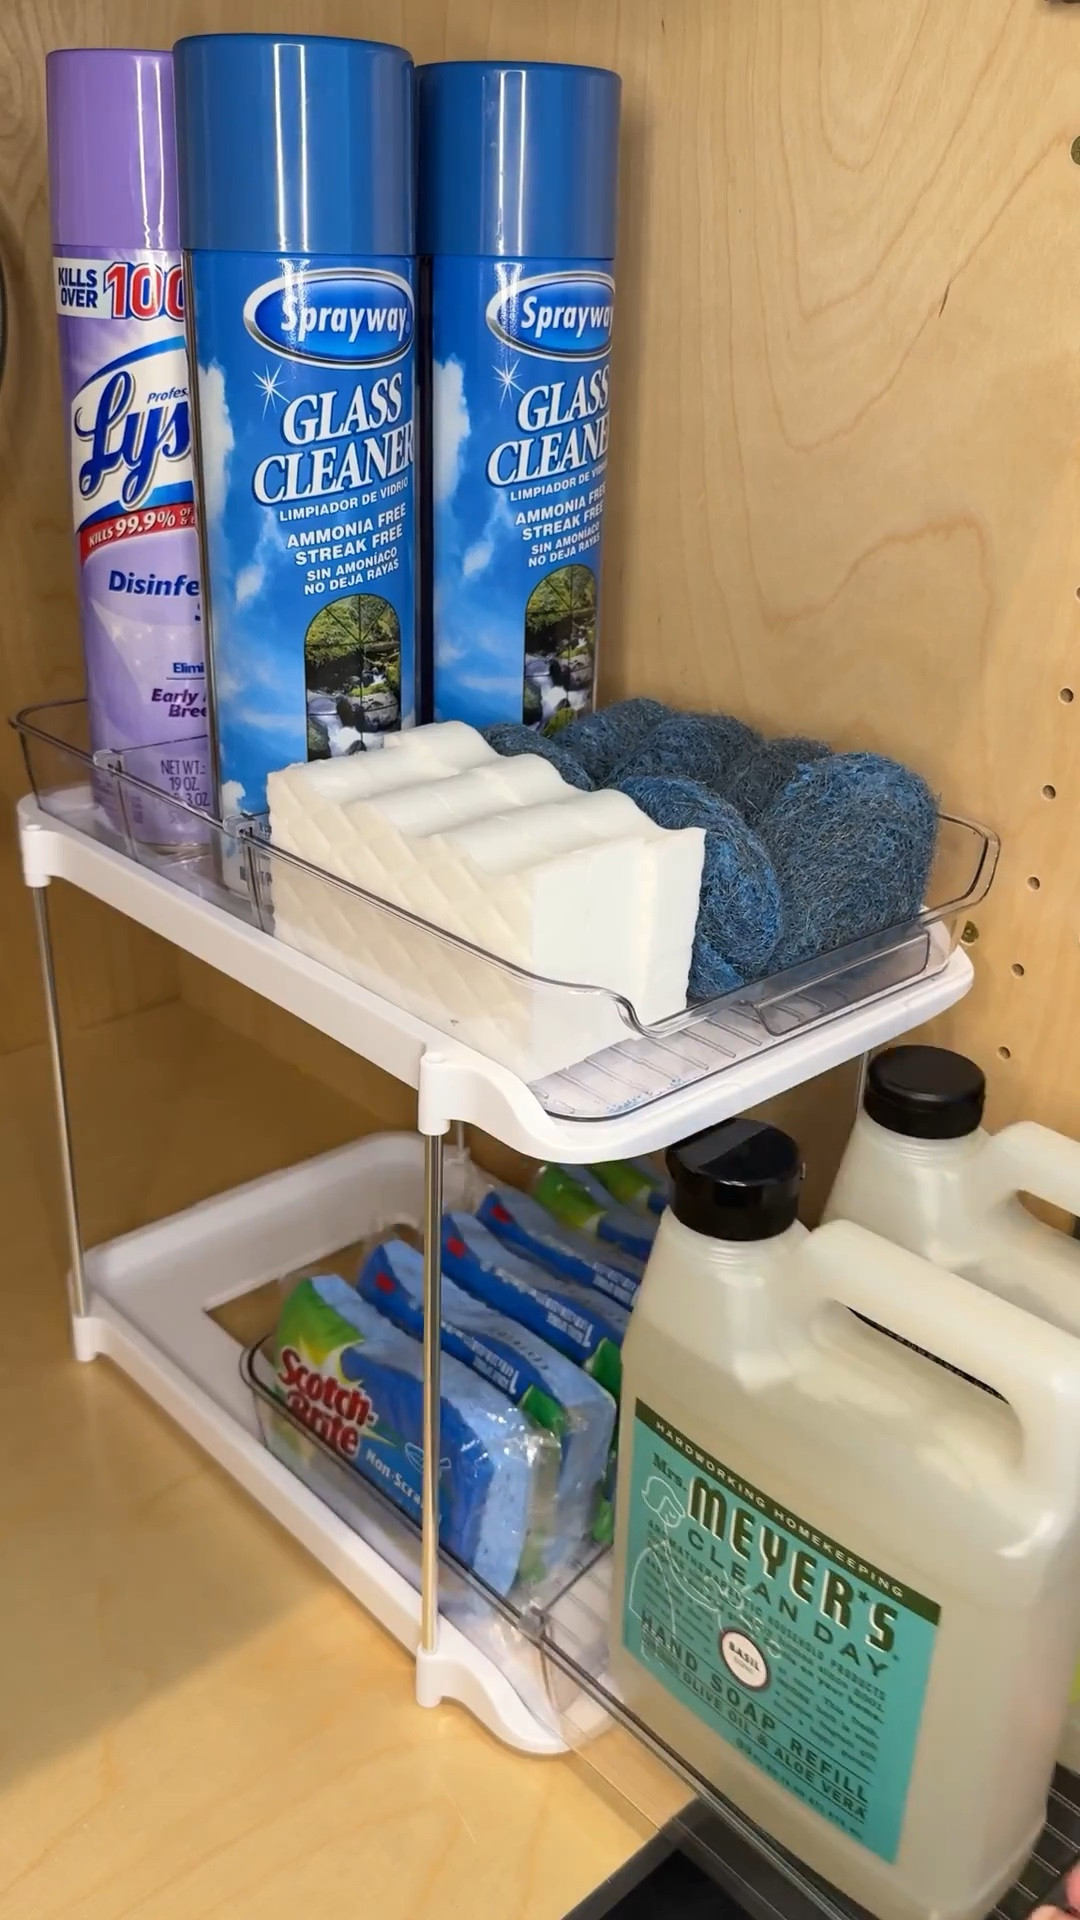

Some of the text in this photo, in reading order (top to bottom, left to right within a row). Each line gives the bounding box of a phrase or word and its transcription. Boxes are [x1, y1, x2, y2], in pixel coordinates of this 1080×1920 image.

[58, 267, 98, 288] KILLS
[60, 287, 98, 308] OVER
[281, 297, 407, 343] Sprayway
[283, 372, 402, 445] GLASS
[518, 364, 610, 432] GLASS
[73, 370, 190, 508] Lys
[253, 423, 414, 504] CLEANER
[279, 476, 409, 522] LIMPIADOR DE VIDRIO
[510, 472, 590, 502] LIMPIADOR DE
[88, 510, 177, 548] KILLS 99.9%
[286, 502, 406, 549] AMMONIA FREE
[515, 495, 586, 526] AMMONIA
[522, 499, 604, 541] STREAK FREE
[295, 523, 403, 565] STREAK FREE
[528, 554, 546, 568] NO
[550, 545, 576, 563] DEJA
[531, 541, 552, 555] SIN
[108, 570, 200, 596] Disinfe
[304, 558, 400, 596] NO DEJA RAYAS
[307, 546, 398, 582] SIN AMONÍACO
[151, 688, 199, 706] Early
[160, 760, 180, 775] NET
[169, 777, 181, 791] 19
[656, 1421, 766, 1508] HARDWORKING
[773, 1508, 903, 1598] HOMEKEEPING
[687, 1529, 799, 1623] CLEAN
[813, 1620, 889, 1678] DAY
[728, 1641, 760, 1672] BASIL
[641, 1610, 698, 1673] HAND
[710, 1673, 776, 1731] SOAP
[789, 1737, 869, 1804] REFILL
[727, 1709, 750, 1735] OIL
[774, 1747, 816, 1784] ALOE
[821, 1779, 867, 1820] VERA
